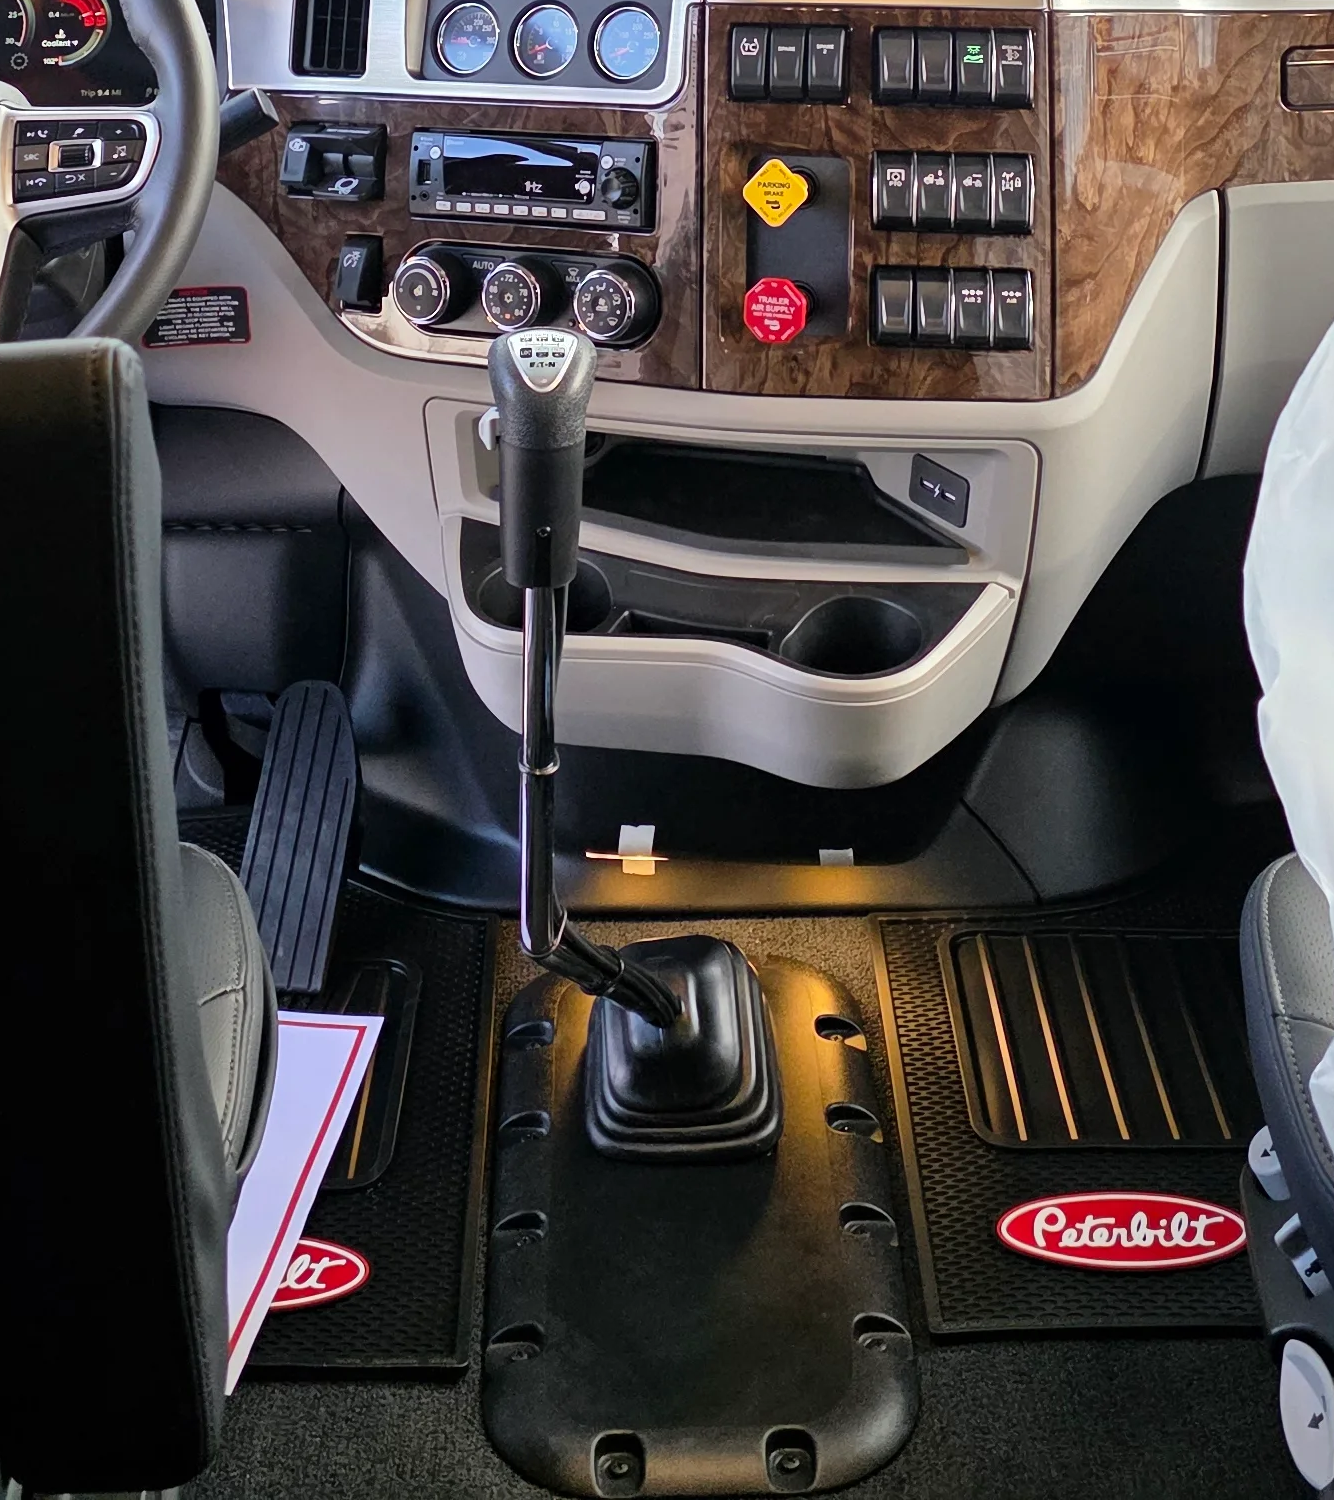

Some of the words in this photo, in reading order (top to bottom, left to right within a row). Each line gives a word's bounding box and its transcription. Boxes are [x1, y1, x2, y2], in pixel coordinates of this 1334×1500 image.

[743, 42, 757, 52] TC
[23, 151, 40, 163] SRC
[757, 181, 791, 190] PARKING
[472, 260, 495, 270] AUTO
[504, 274, 514, 283] 72
[565, 275, 581, 283] MAX
[758, 295, 790, 306] TRAILER
[750, 303, 765, 312] AIR
[765, 304, 796, 314] SUPPLY
[1033, 1206, 1225, 1248] Peterbilt
